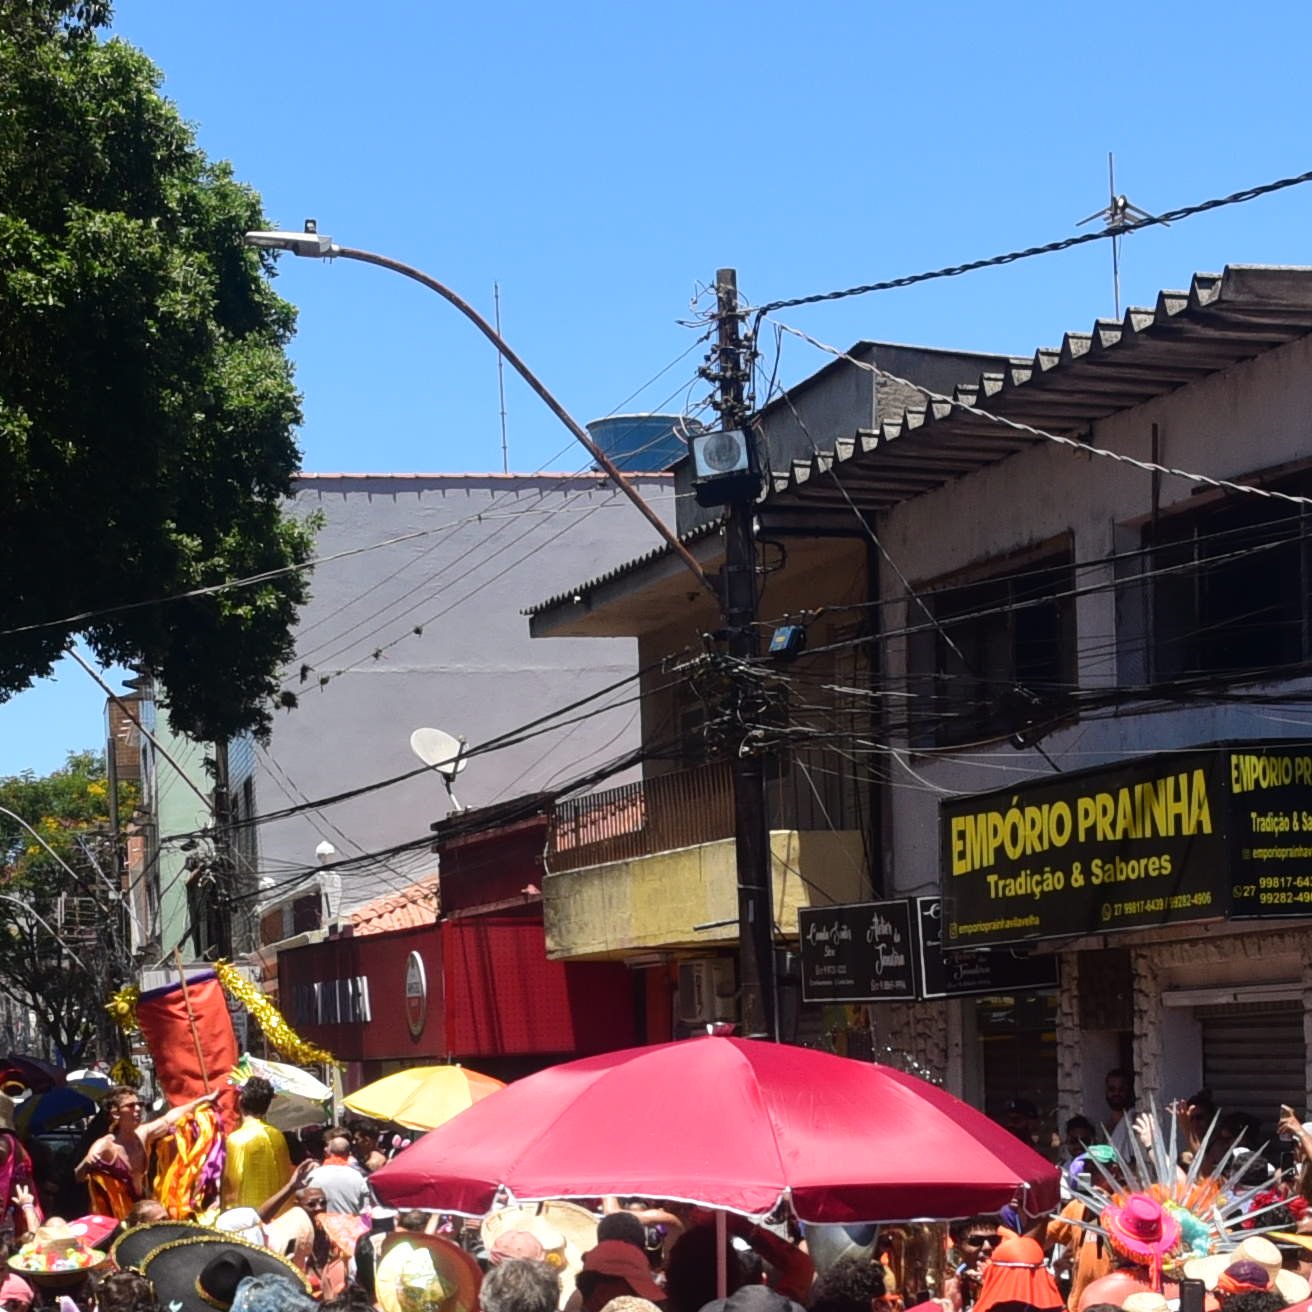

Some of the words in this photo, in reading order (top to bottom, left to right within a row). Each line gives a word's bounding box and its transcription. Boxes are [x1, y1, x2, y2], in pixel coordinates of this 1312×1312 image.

[951, 795, 1073, 876] EMPÓRIO
[1077, 769, 1213, 842] PRAINHA
[1250, 811, 1290, 837] Tradição
[1292, 811, 1300, 832] &
[987, 866, 1065, 900] Tradição
[1070, 861, 1085, 888] &
[1091, 854, 1172, 885] Sabores
[1243, 885, 1256, 897] 27
